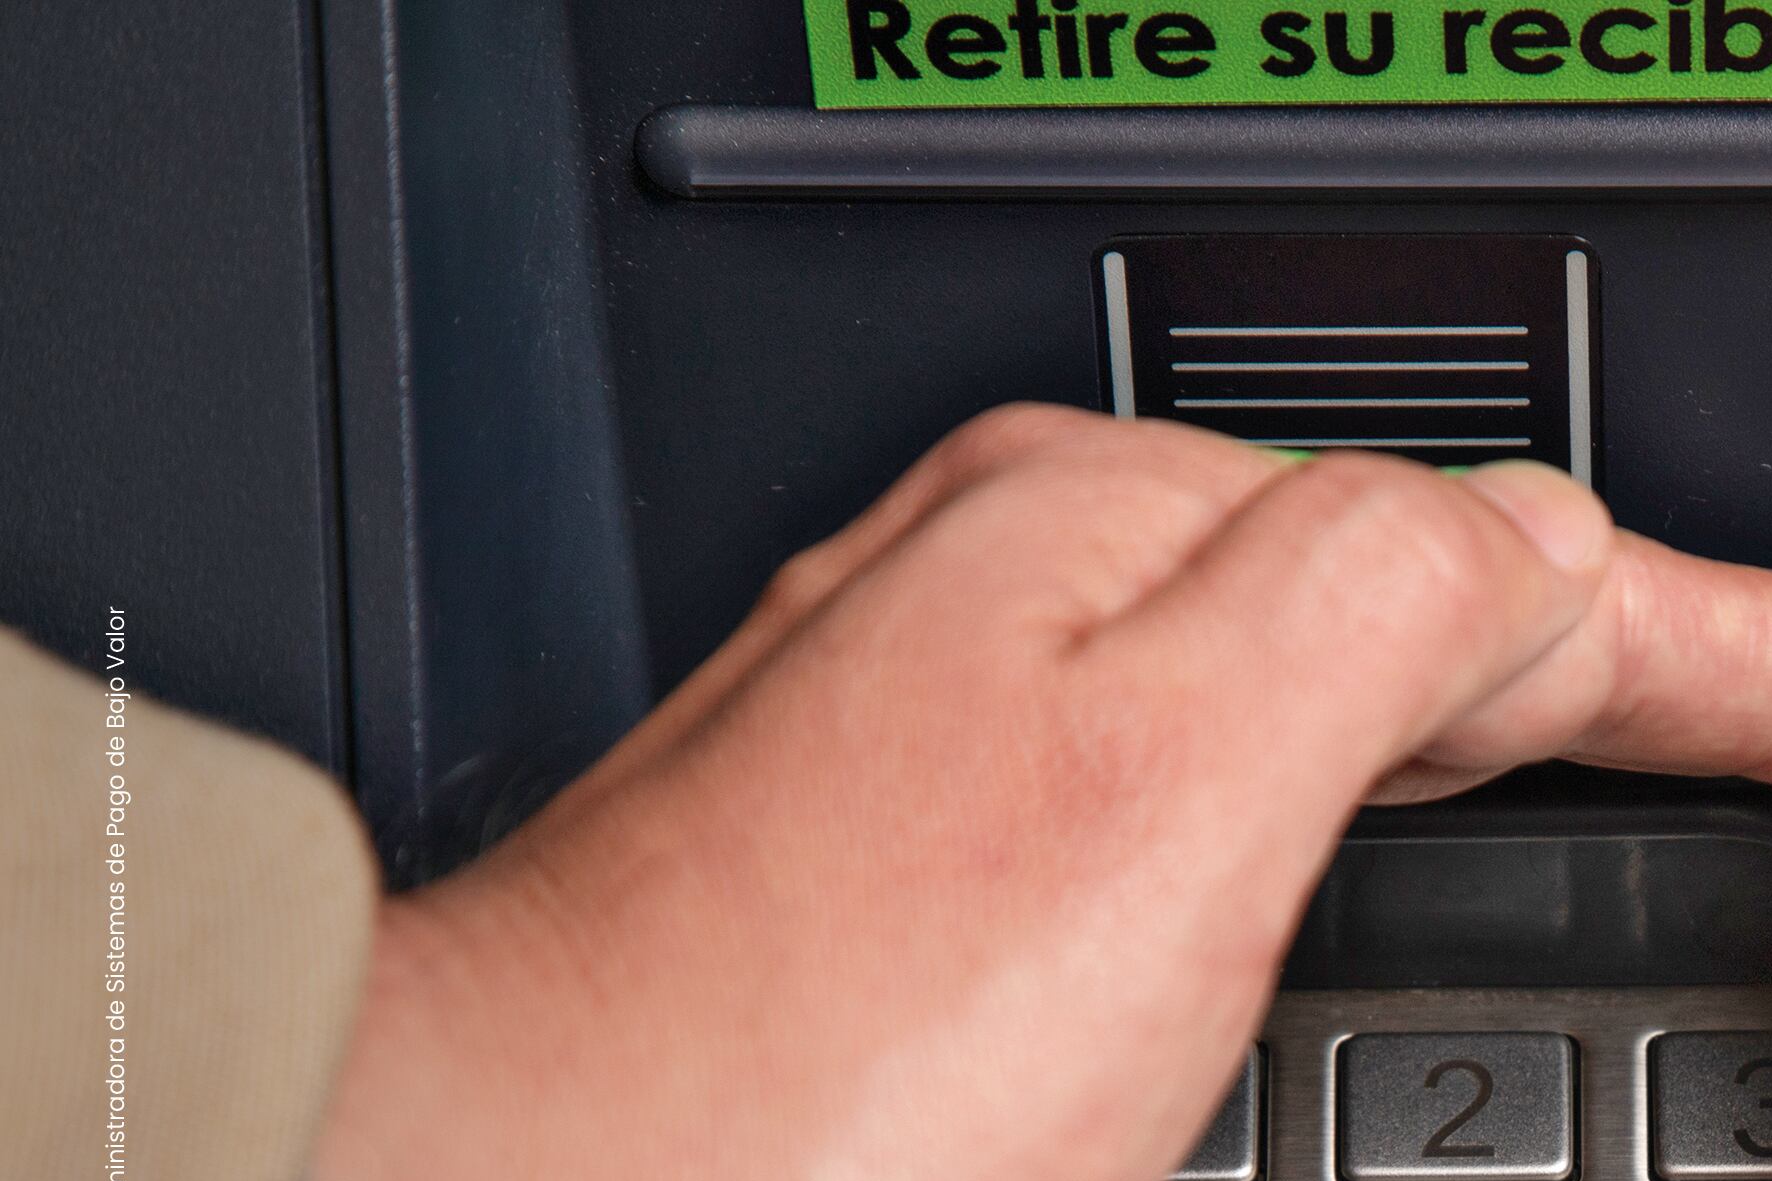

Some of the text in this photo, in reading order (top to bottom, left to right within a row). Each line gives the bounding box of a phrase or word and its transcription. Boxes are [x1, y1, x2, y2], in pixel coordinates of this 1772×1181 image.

[846, 0, 1217, 80] Retire
[1259, 11, 1396, 78] su
[1421, 1059, 1497, 1159] 2
